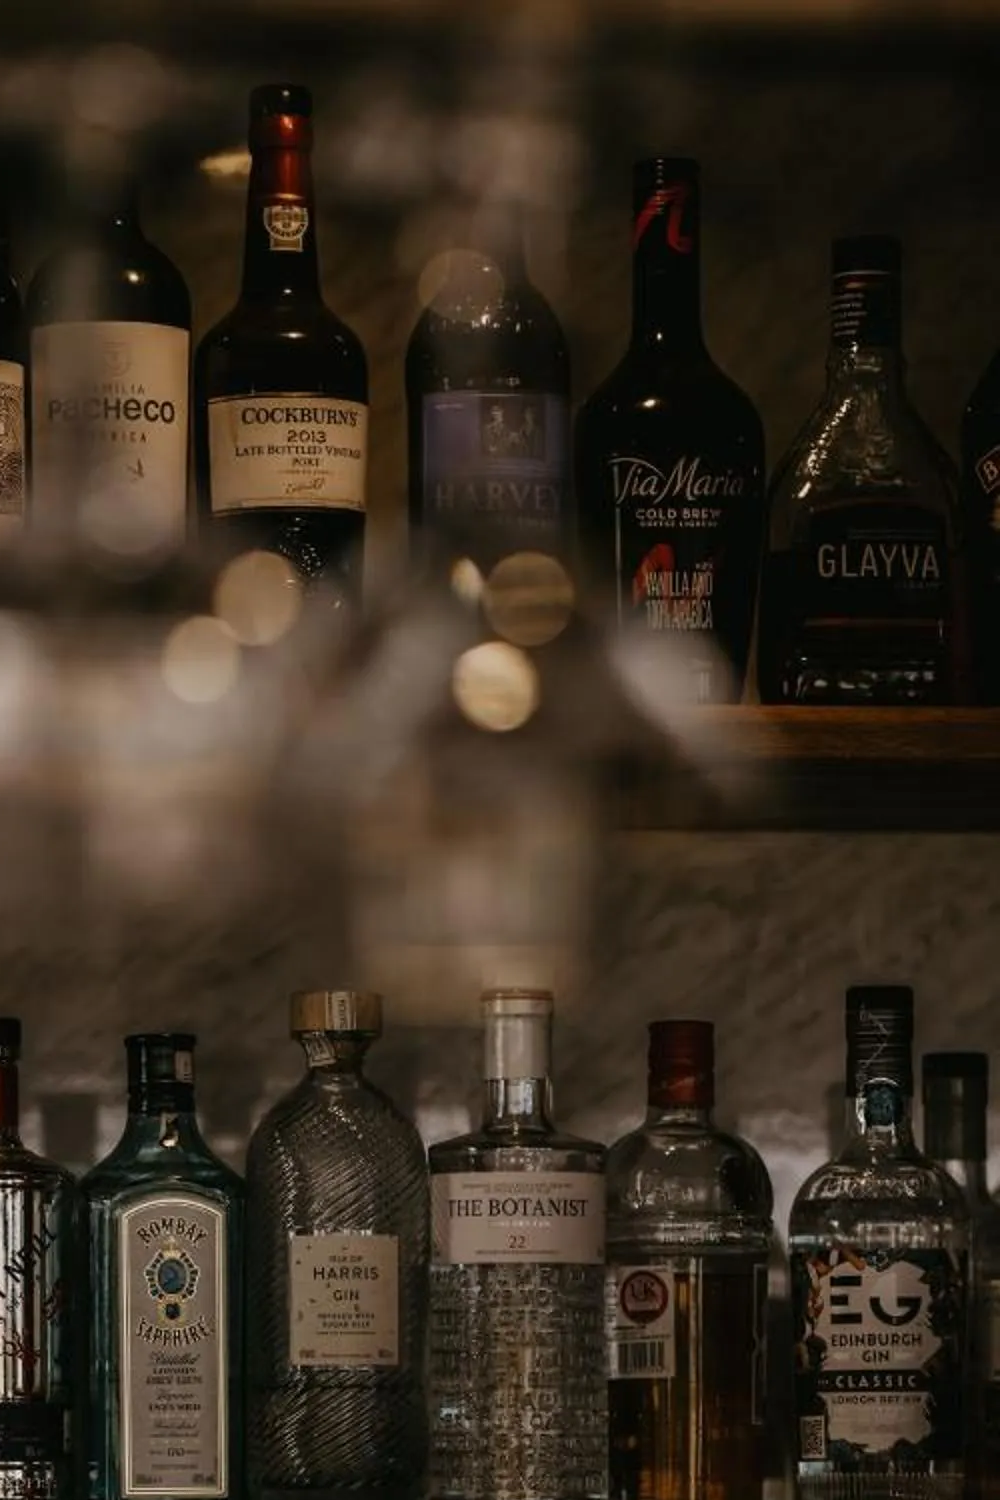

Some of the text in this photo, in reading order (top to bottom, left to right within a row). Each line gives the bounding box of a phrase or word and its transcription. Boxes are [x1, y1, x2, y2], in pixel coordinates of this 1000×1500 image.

[287, 430, 327, 444] 2013
[608, 455, 743, 505] Tia Maria
[636, 508, 722, 519] COLD BREW
[817, 543, 940, 579] GLAYVA
[448, 1198, 588, 1217] THE BOTANIST
[137, 1218, 206, 1244] BOMBAY
[509, 1235, 526, 1249] 22
[314, 1266, 379, 1280] HARRIS
[333, 1289, 359, 1301] GIN
[137, 1317, 208, 1346] SAPPHIRE
[831, 1333, 921, 1347] EDINBURGH
[863, 1350, 889, 1363] GIN
[836, 1374, 917, 1389] CLASSIC
